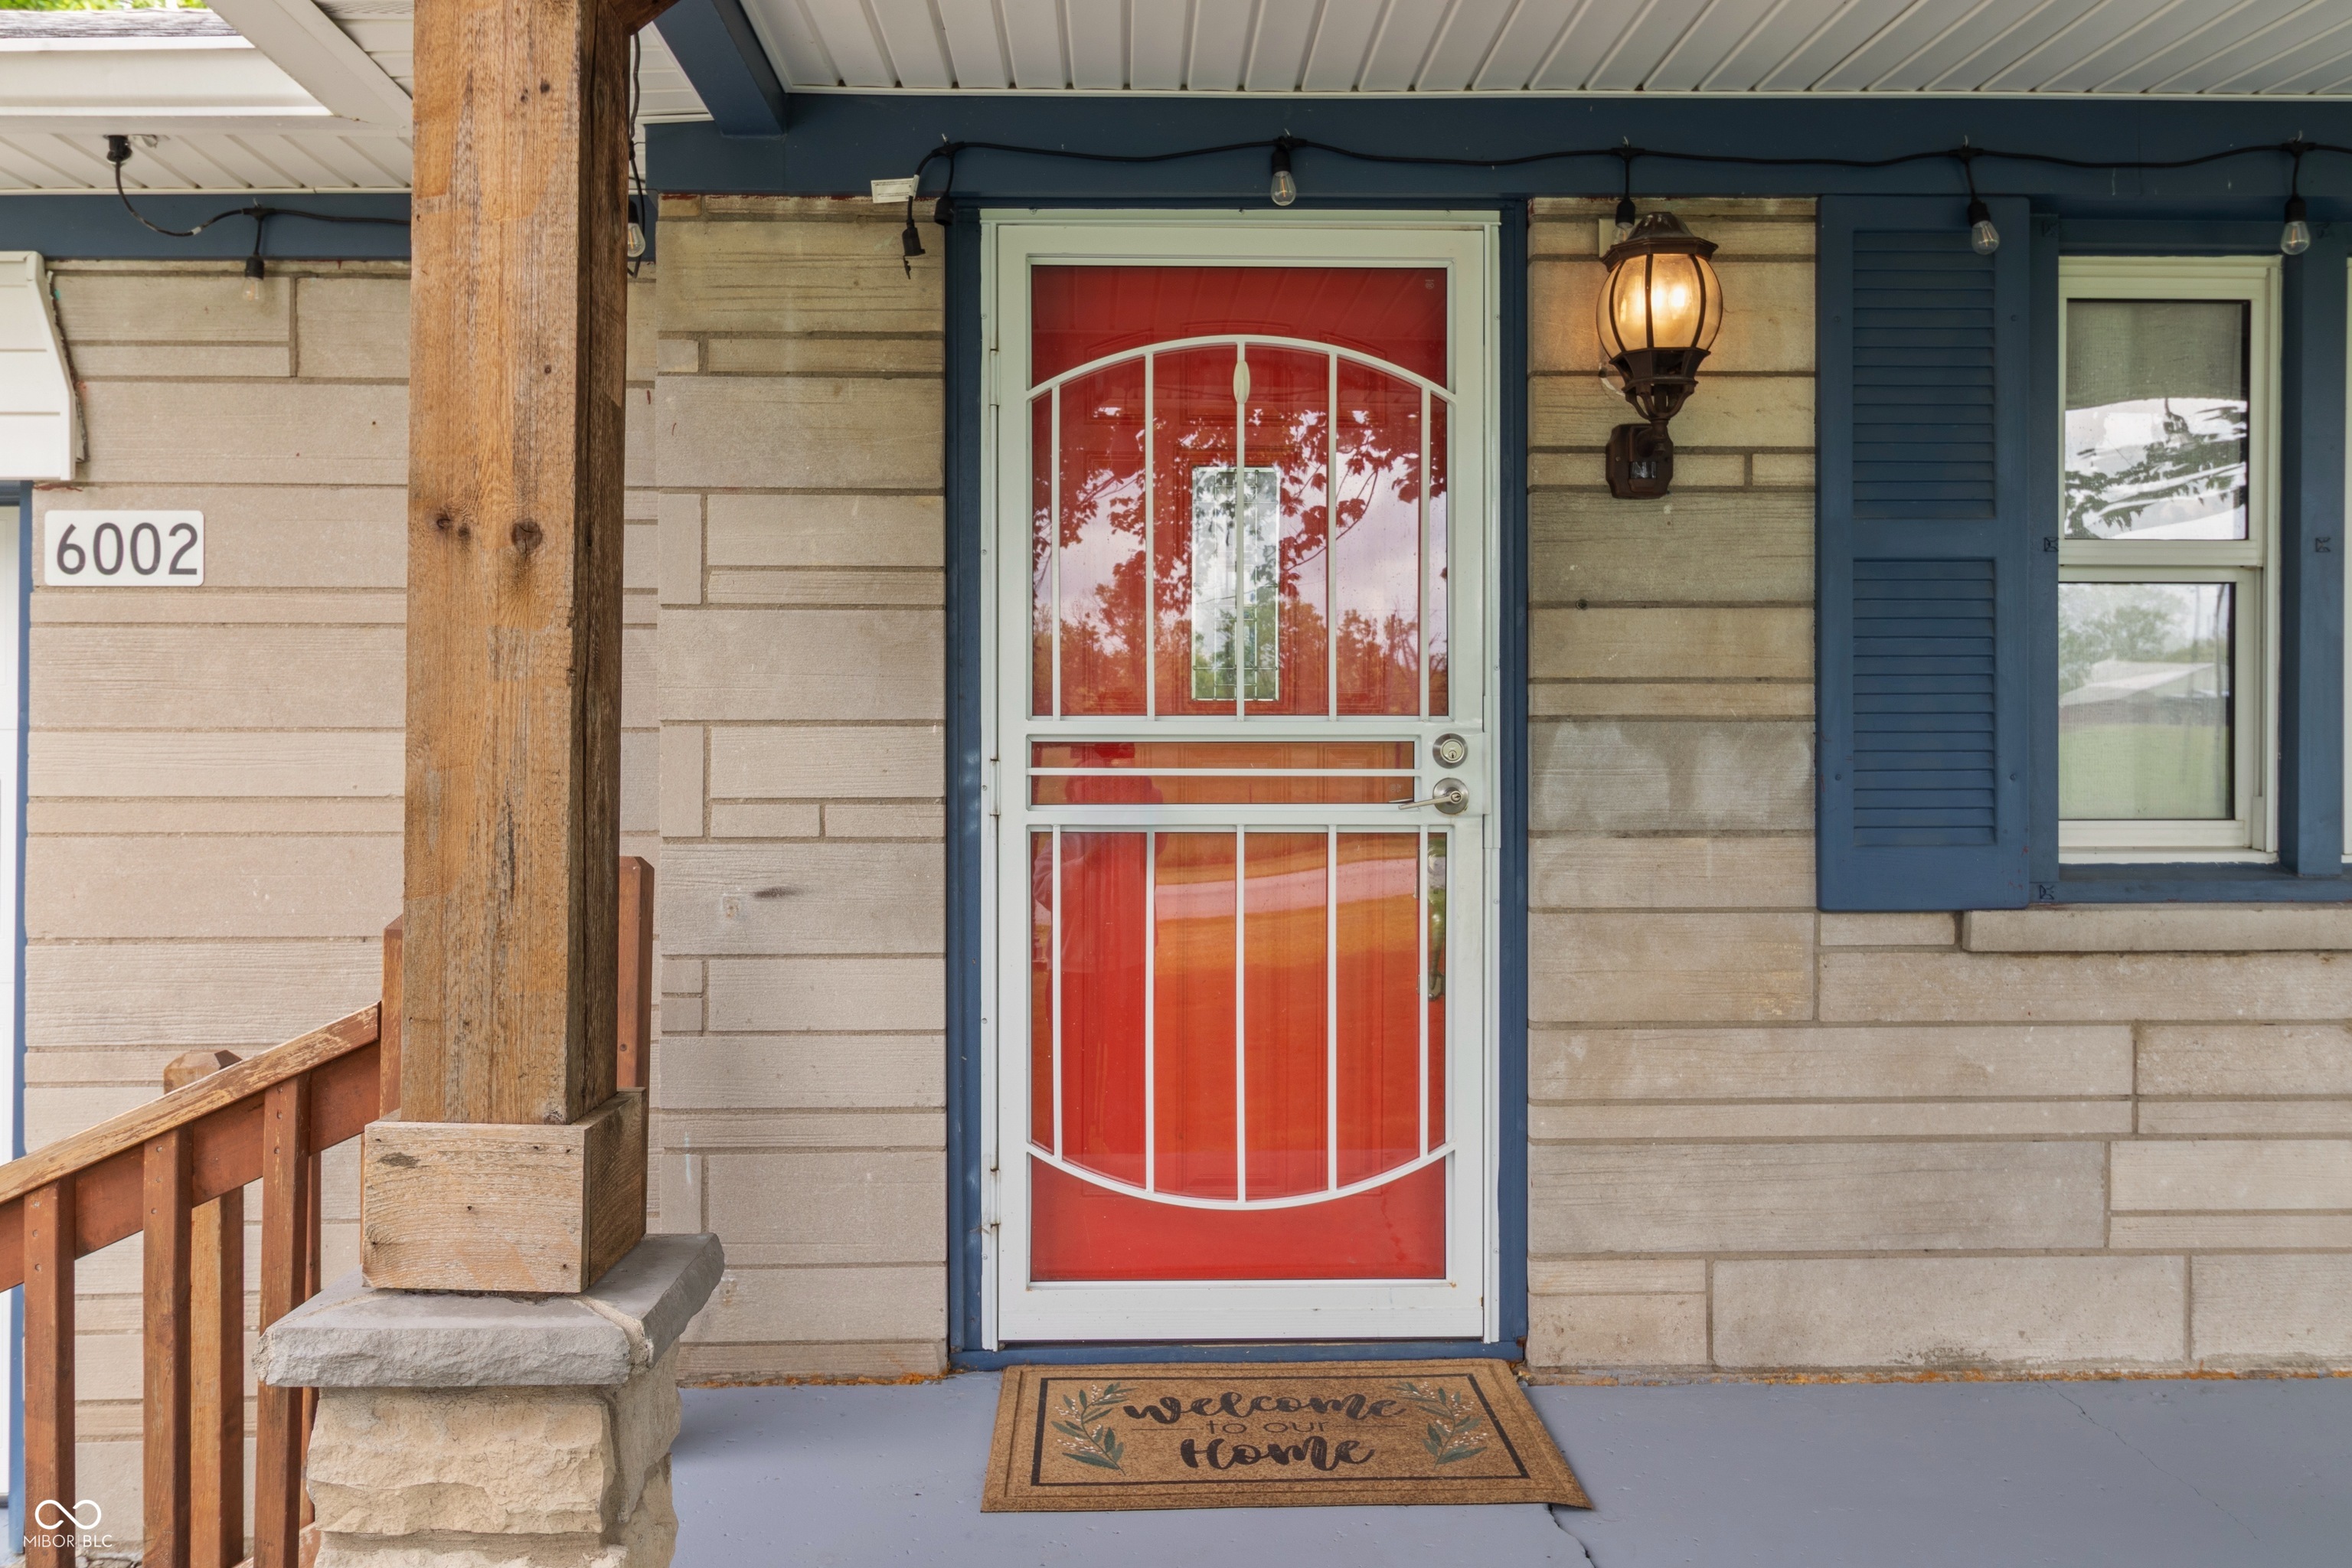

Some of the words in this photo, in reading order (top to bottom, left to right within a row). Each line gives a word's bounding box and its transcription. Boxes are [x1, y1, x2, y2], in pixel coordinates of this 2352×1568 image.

[57, 522, 198, 575] 6002
[1206, 1419, 1247, 1434] to
[1263, 1420, 1329, 1432] our
[1181, 1435, 1375, 1472] Home
